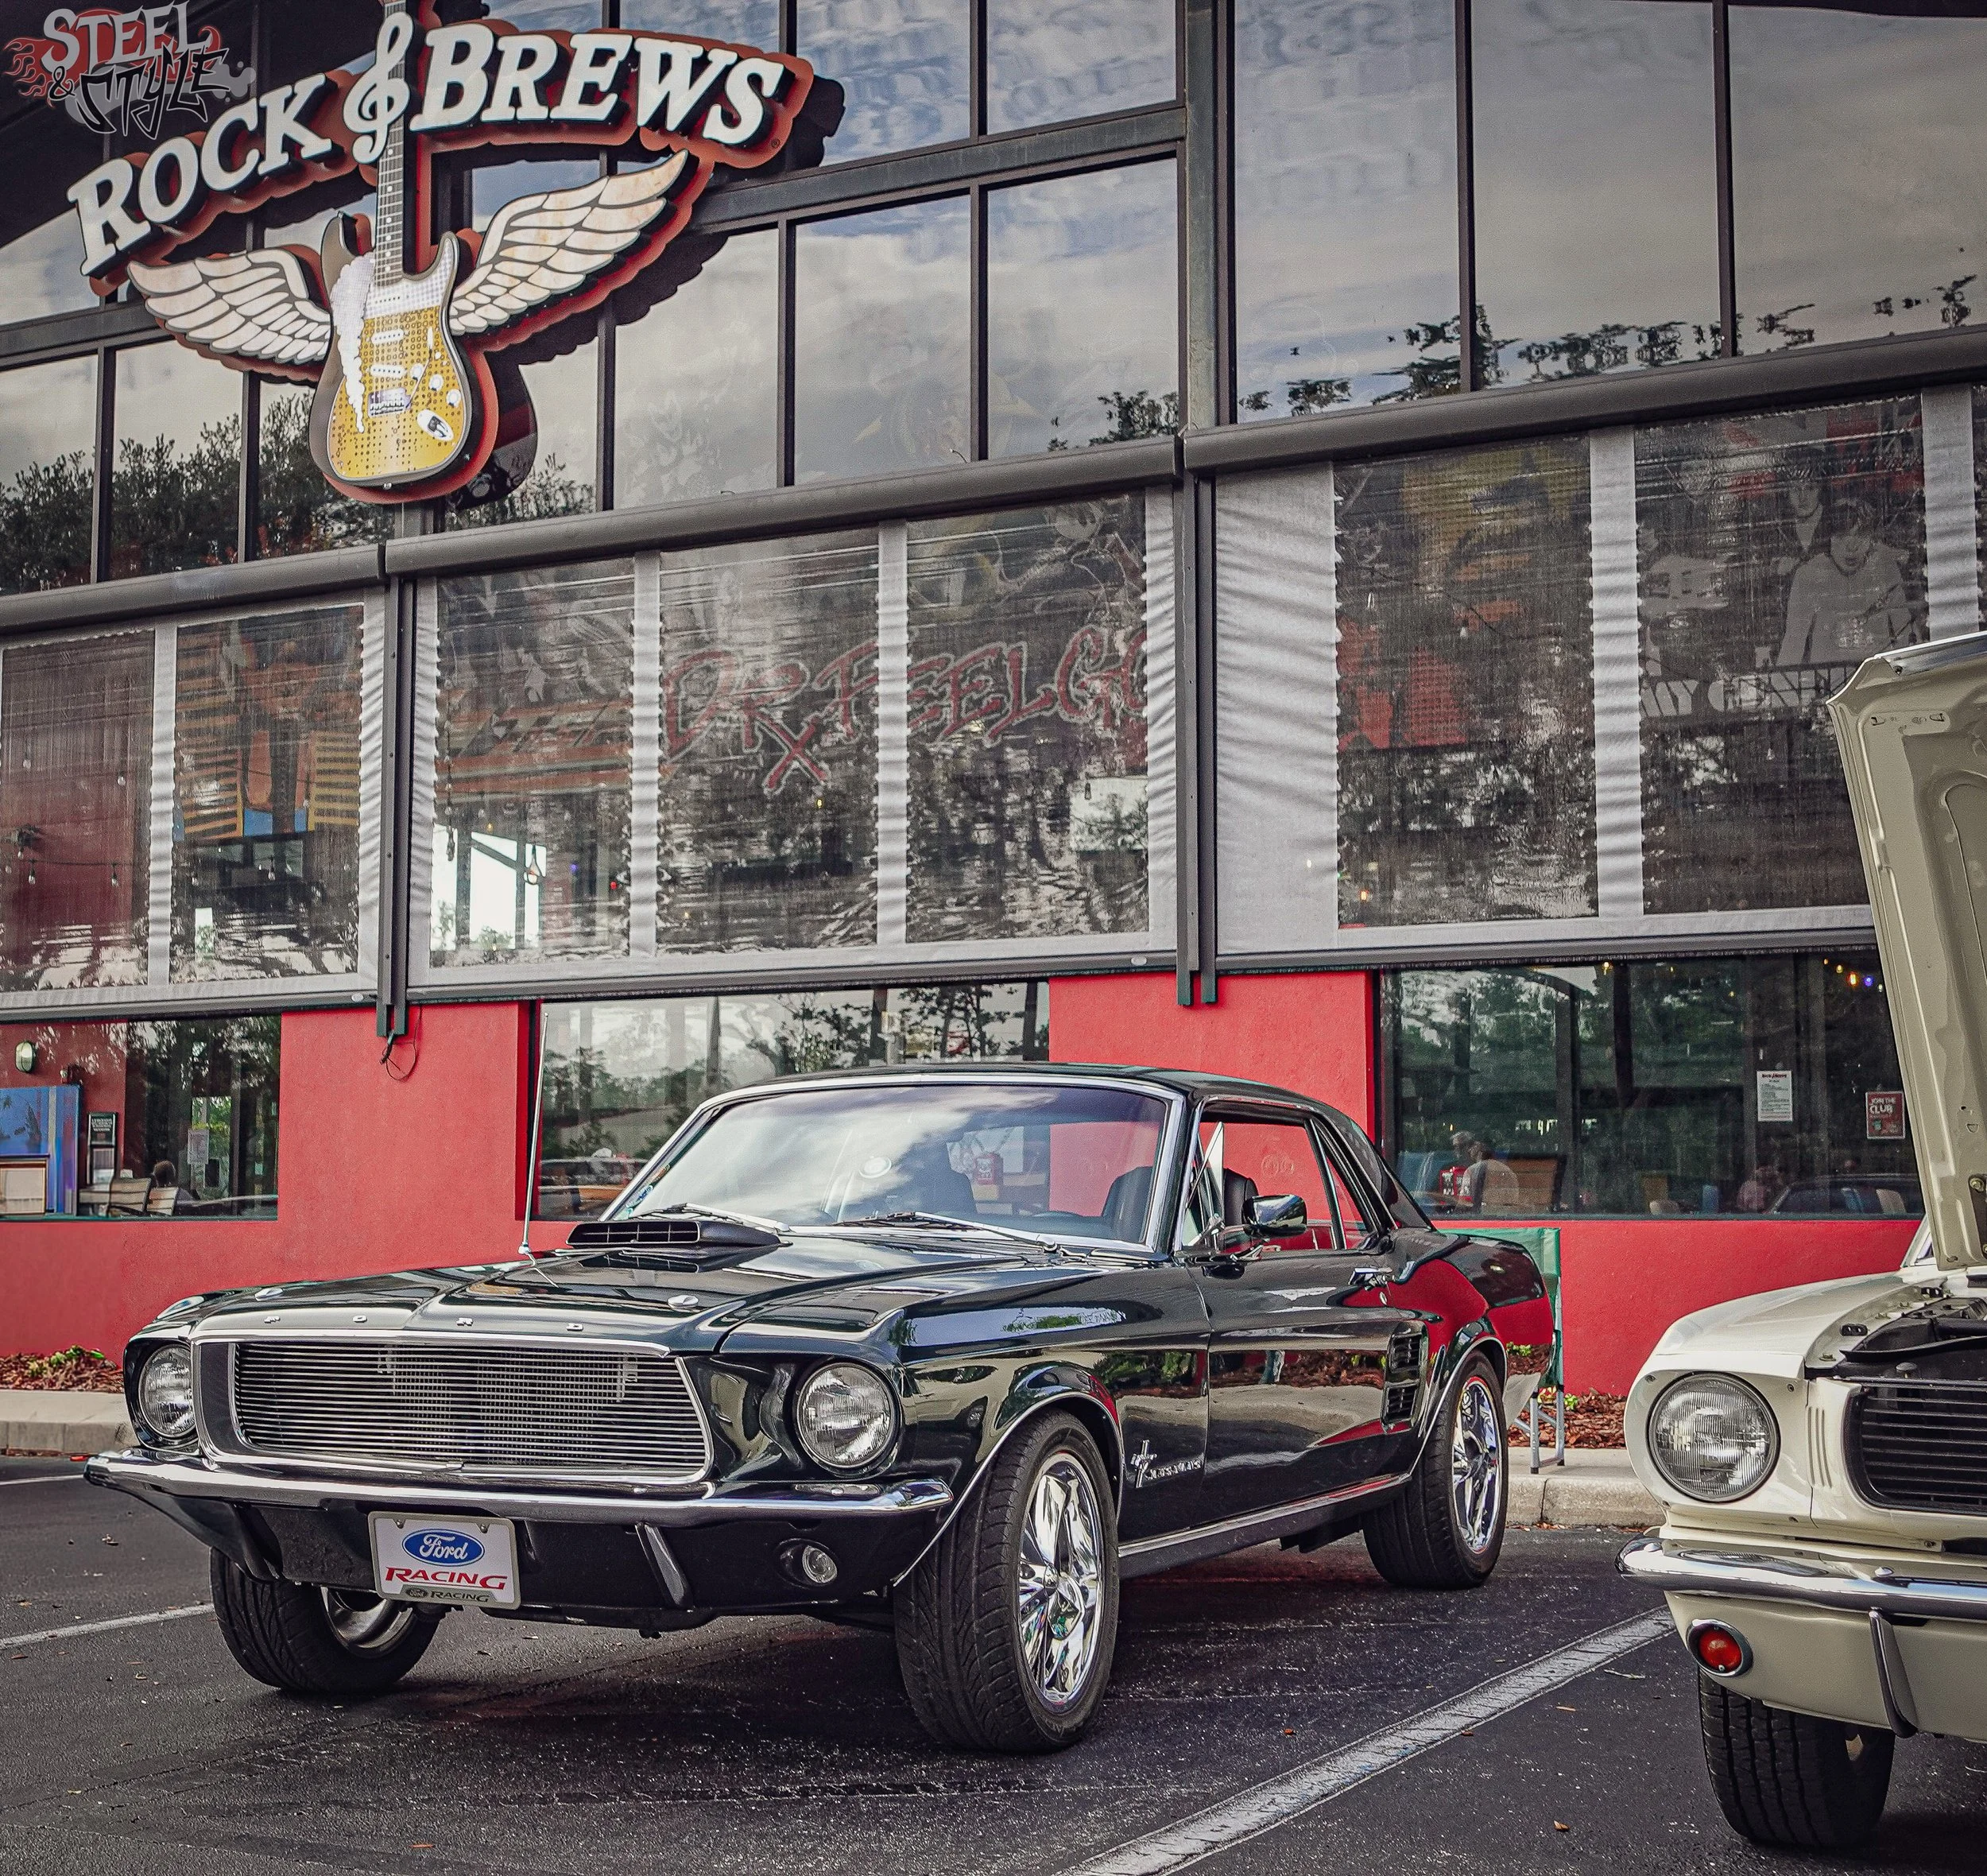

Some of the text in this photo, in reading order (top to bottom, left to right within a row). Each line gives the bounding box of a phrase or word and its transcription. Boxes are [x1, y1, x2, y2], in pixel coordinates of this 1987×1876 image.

[67, 24, 784, 277] ROCK BREWS
[1869, 1104, 1893, 1114] CLUB
[419, 1533, 469, 1560] Ford
[385, 1566, 508, 1590] RACING
[430, 1591, 490, 1603] RACING
